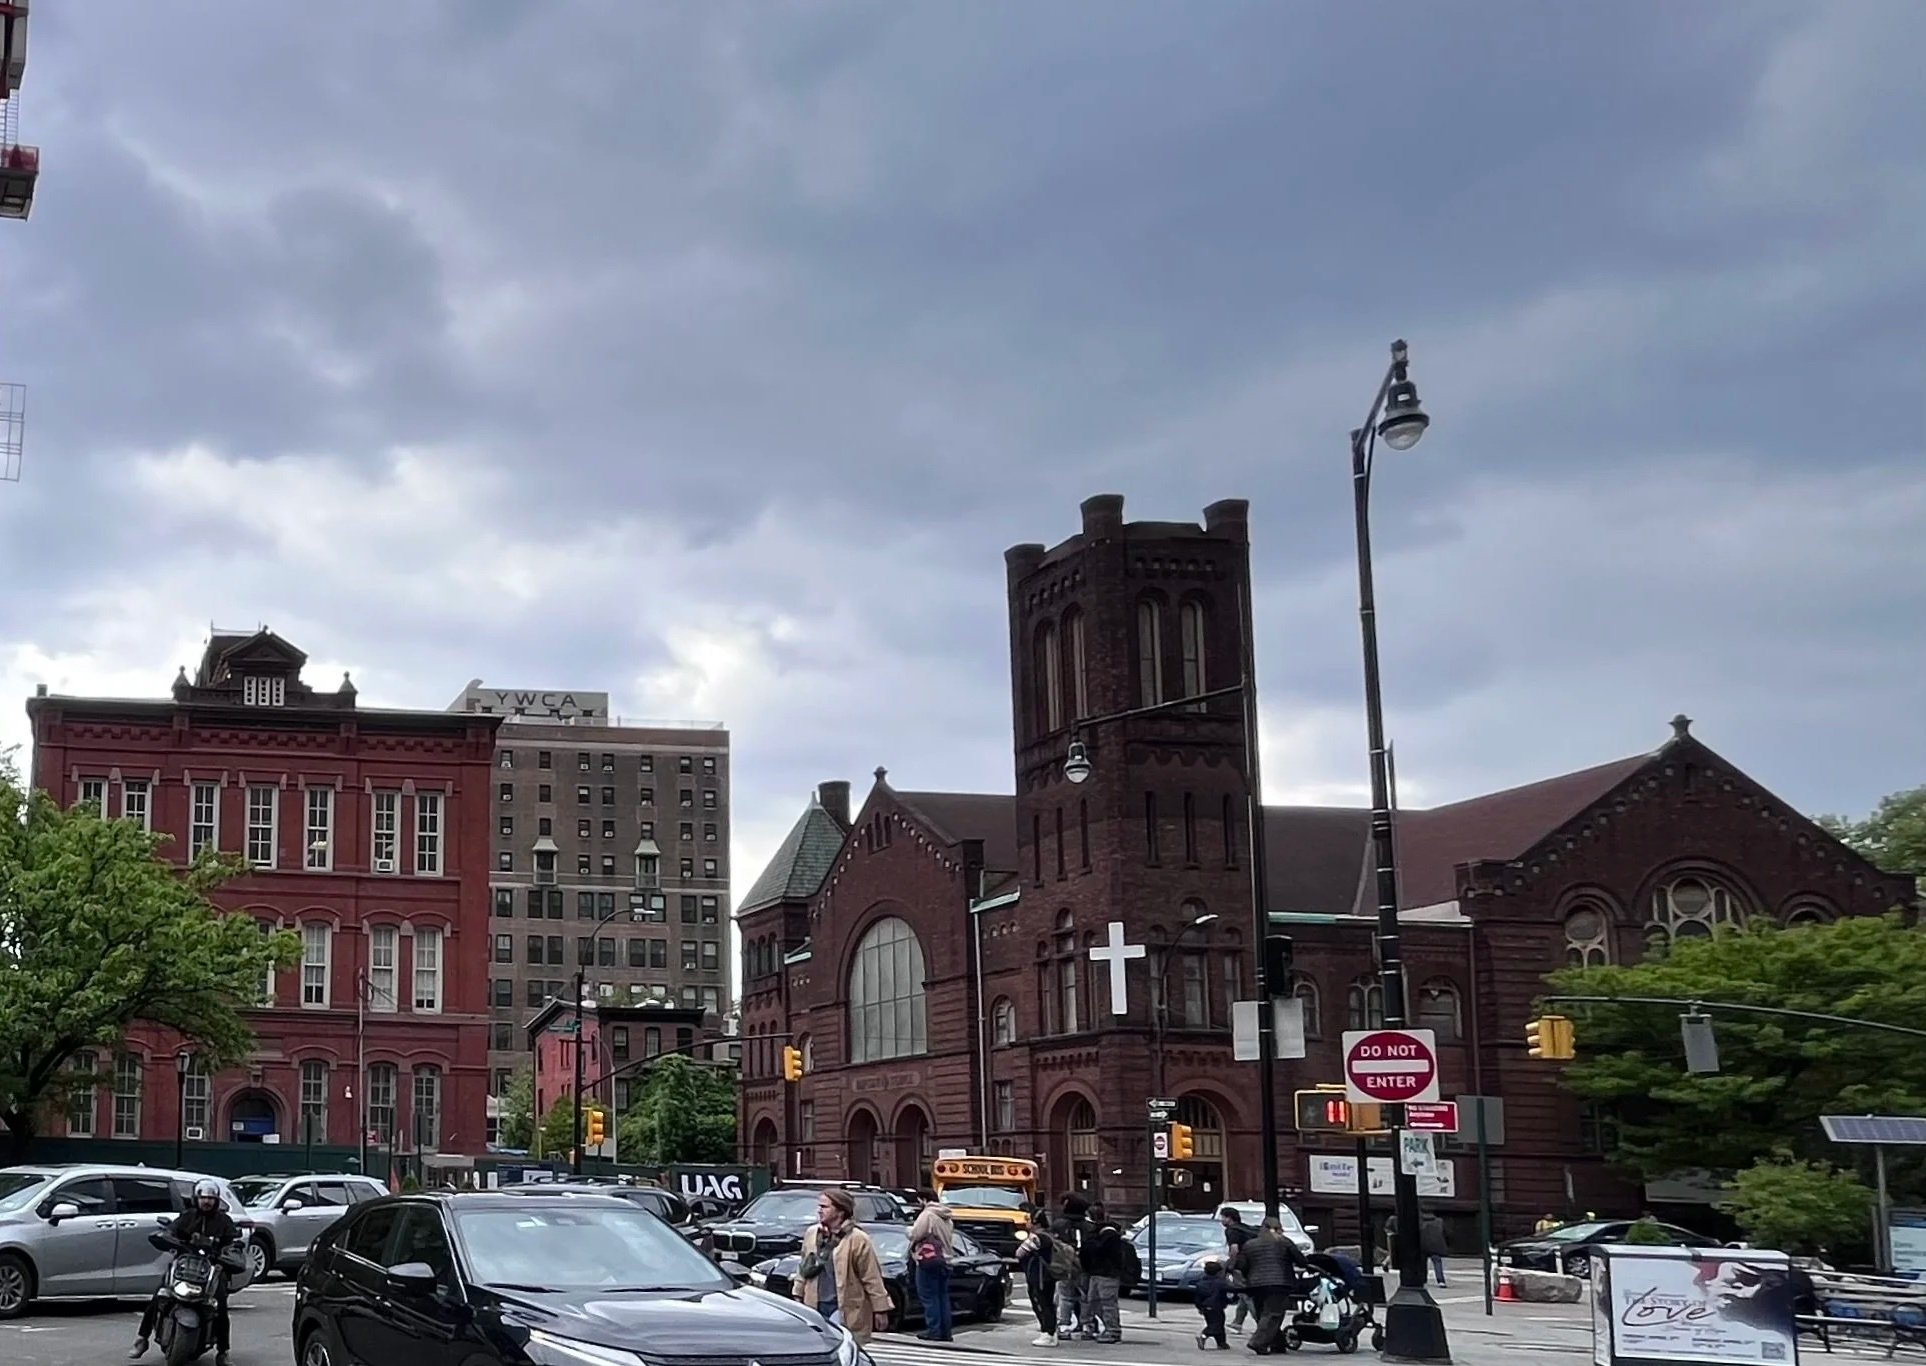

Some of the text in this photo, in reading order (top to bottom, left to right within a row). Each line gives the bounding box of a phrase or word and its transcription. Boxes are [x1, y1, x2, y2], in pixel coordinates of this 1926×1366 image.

[495, 691, 577, 708] YWCA
[1360, 1044, 1417, 1057] DO NOT
[1366, 1076, 1417, 1088] ENTER
[963, 1164, 1005, 1176] SCHOOL BUS
[681, 1174, 743, 1200] UAG
[1621, 1286, 1716, 1327] Love
